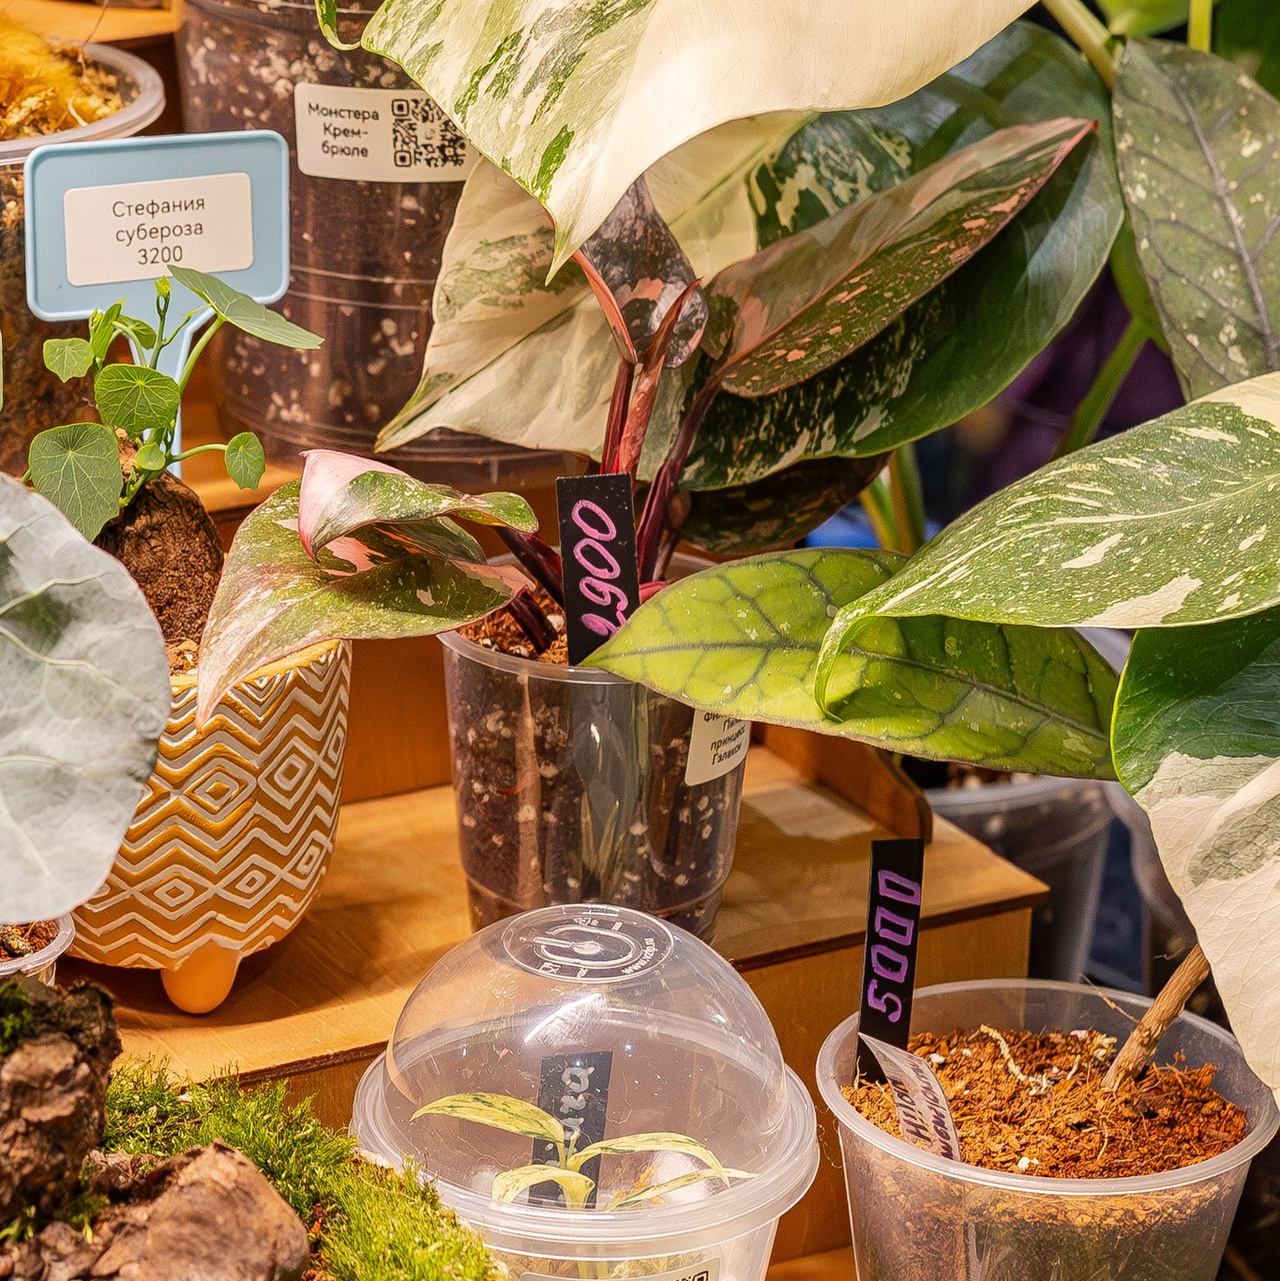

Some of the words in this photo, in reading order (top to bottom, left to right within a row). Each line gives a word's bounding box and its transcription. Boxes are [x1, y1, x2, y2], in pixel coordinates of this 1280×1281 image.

[307, 102, 380, 122] Монстера
[322, 122, 369, 140] Крем-
[321, 140, 369, 158] брюле
[112, 197, 206, 219] Стефания
[115, 222, 204, 247] субероза
[137, 245, 184, 266] 3200
[867, 870, 921, 1024] 5000
